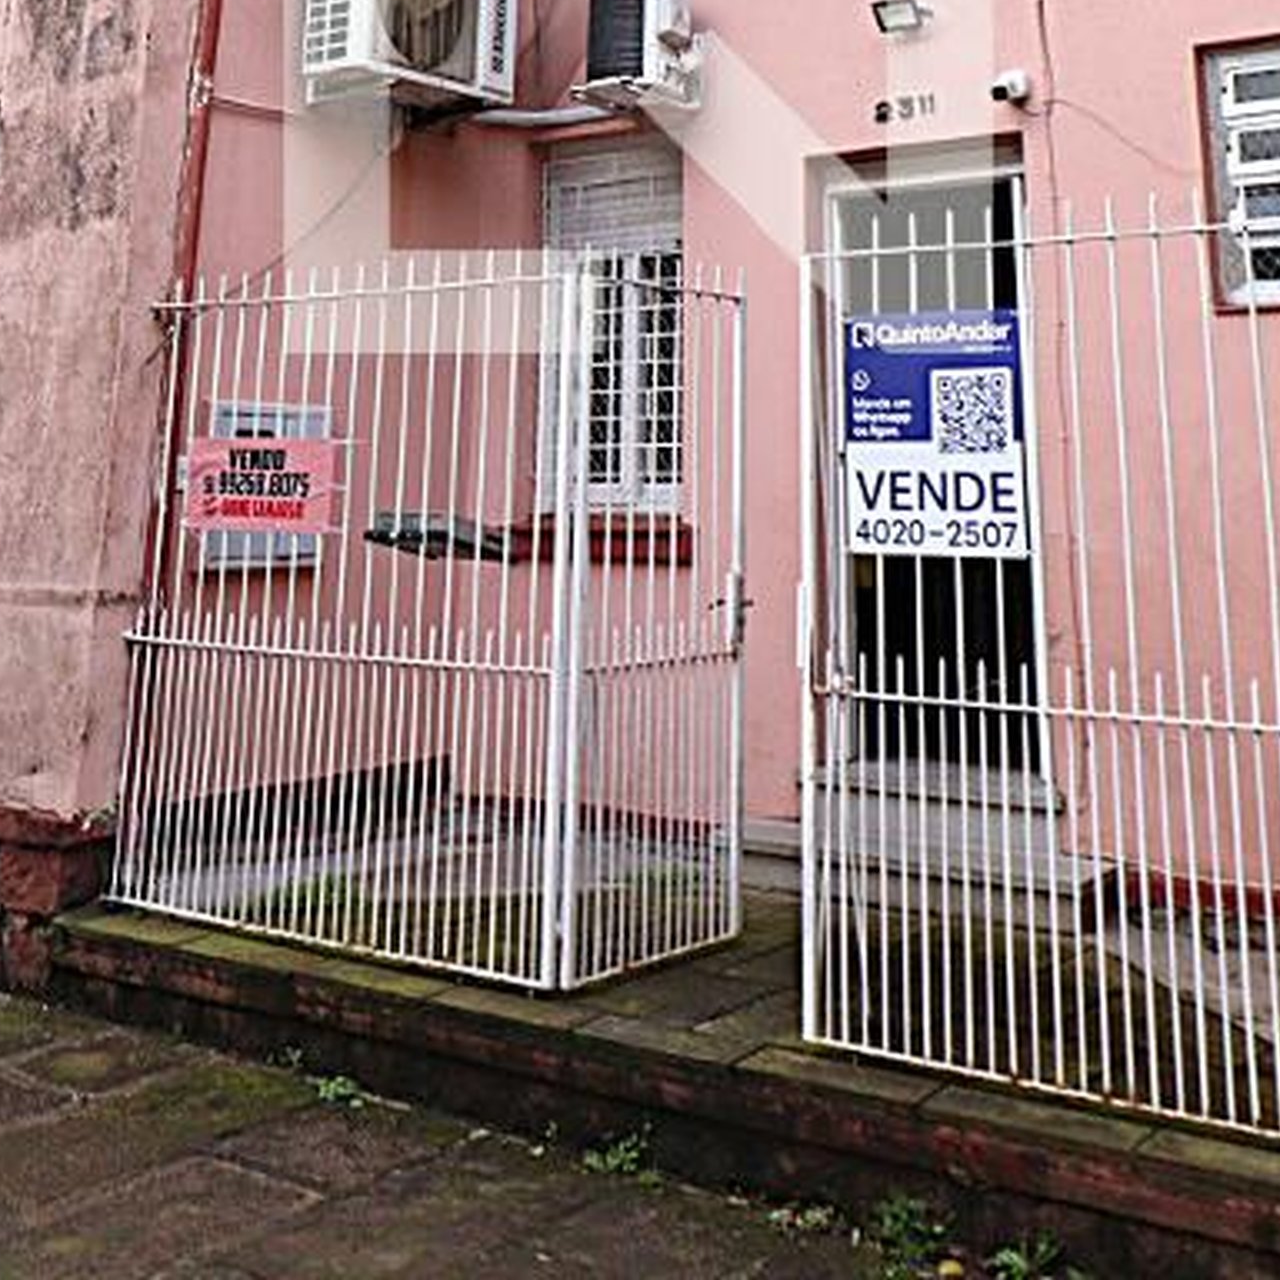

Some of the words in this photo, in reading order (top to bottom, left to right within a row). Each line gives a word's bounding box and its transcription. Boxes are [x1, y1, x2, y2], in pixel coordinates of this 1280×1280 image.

[876, 320, 1011, 344] QuintoAndar
[856, 471, 1017, 513] VENDE
[856, 519, 1017, 548] 4020-2507
